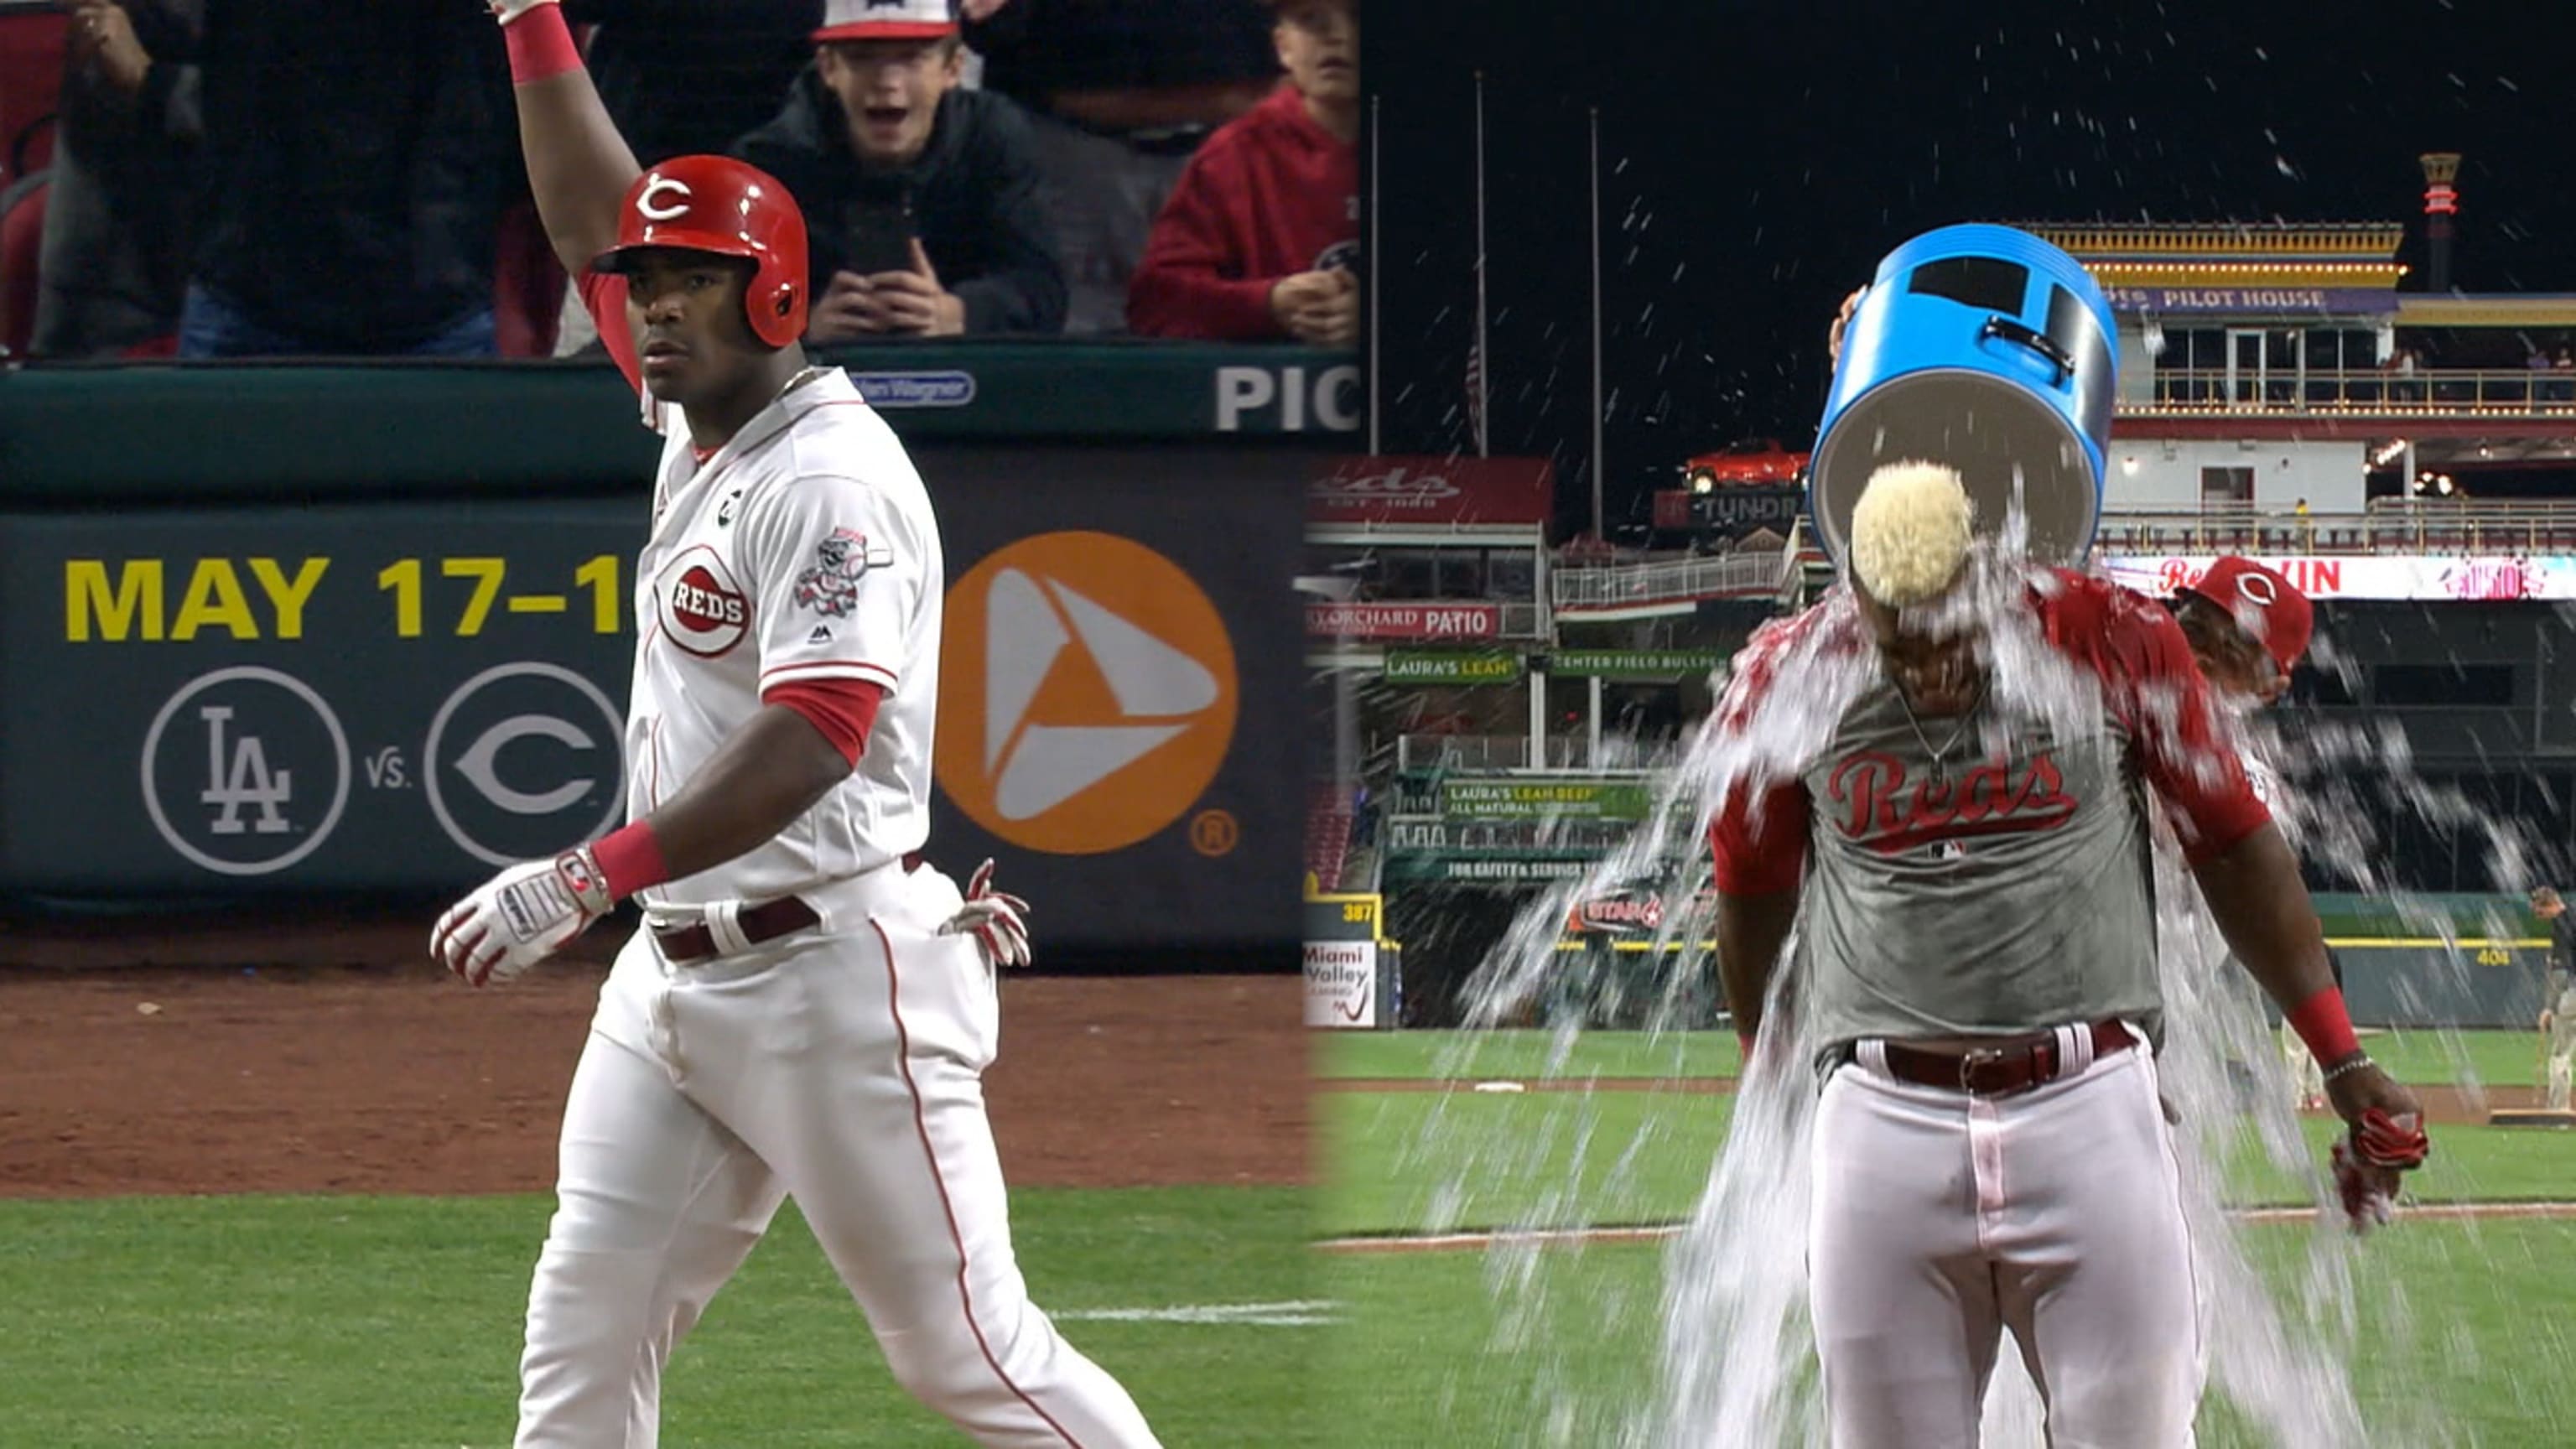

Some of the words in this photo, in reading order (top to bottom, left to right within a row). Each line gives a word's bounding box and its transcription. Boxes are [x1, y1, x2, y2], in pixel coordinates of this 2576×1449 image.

[2163, 290, 2235, 308] PILOT
[2243, 290, 2324, 308] HOUSE
[1217, 365, 1360, 431] PIC
[65, 557, 330, 642] MAY
[673, 582, 744, 625] REDS
[1328, 610, 1418, 626] ORCHARD
[1426, 611, 1487, 633] PATIO
[1388, 660, 1457, 675] LAURA'S
[1462, 660, 1507, 675] LEAN
[1554, 656, 1612, 668] CENTER
[1615, 656, 1659, 668] FIELD
[200, 706, 291, 834] LA
[454, 714, 597, 814] C
[1450, 787, 1511, 800] LAURA'S
[1514, 787, 1552, 801] LEAN
[1828, 749, 2080, 858] Reds
[1449, 803, 1471, 813] ALL
[1474, 803, 1533, 813] NATURAL
[1343, 903, 1373, 922] 387
[1303, 945, 1363, 963] Miami
[2477, 948, 2511, 966] 404
[1306, 967, 1368, 987] Valley
